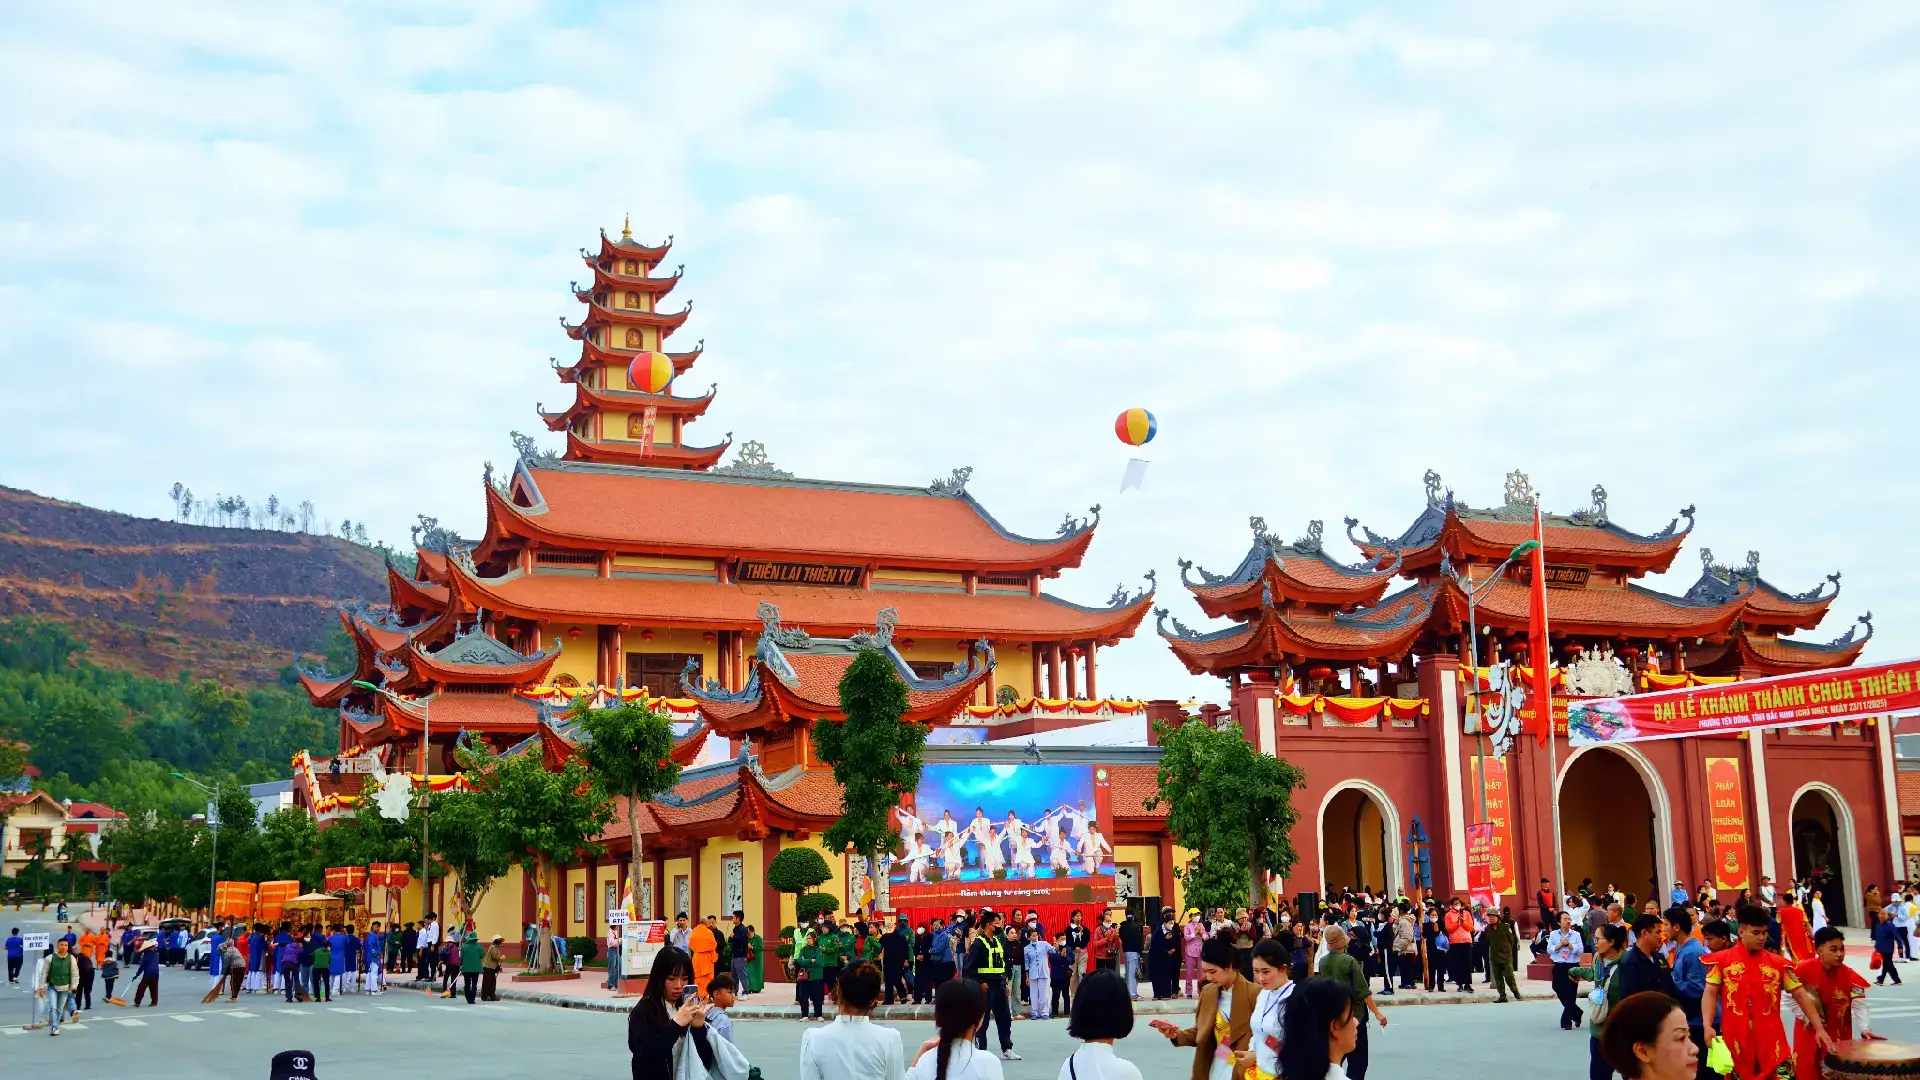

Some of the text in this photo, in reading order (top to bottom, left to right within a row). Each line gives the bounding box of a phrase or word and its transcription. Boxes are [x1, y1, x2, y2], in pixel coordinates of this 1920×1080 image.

[747, 562, 780, 579] THIÊN
[780, 565, 801, 580] LAI
[803, 565, 837, 582] THIÊN
[1654, 701, 1677, 724] ĐẠI
[1680, 694, 1697, 718] LỄ
[1700, 692, 1749, 716] KHÁNH
[1752, 684, 1806, 711] THÀNH
[1808, 678, 1855, 703] CHÙA
[1858, 669, 1911, 698] THIÊN
